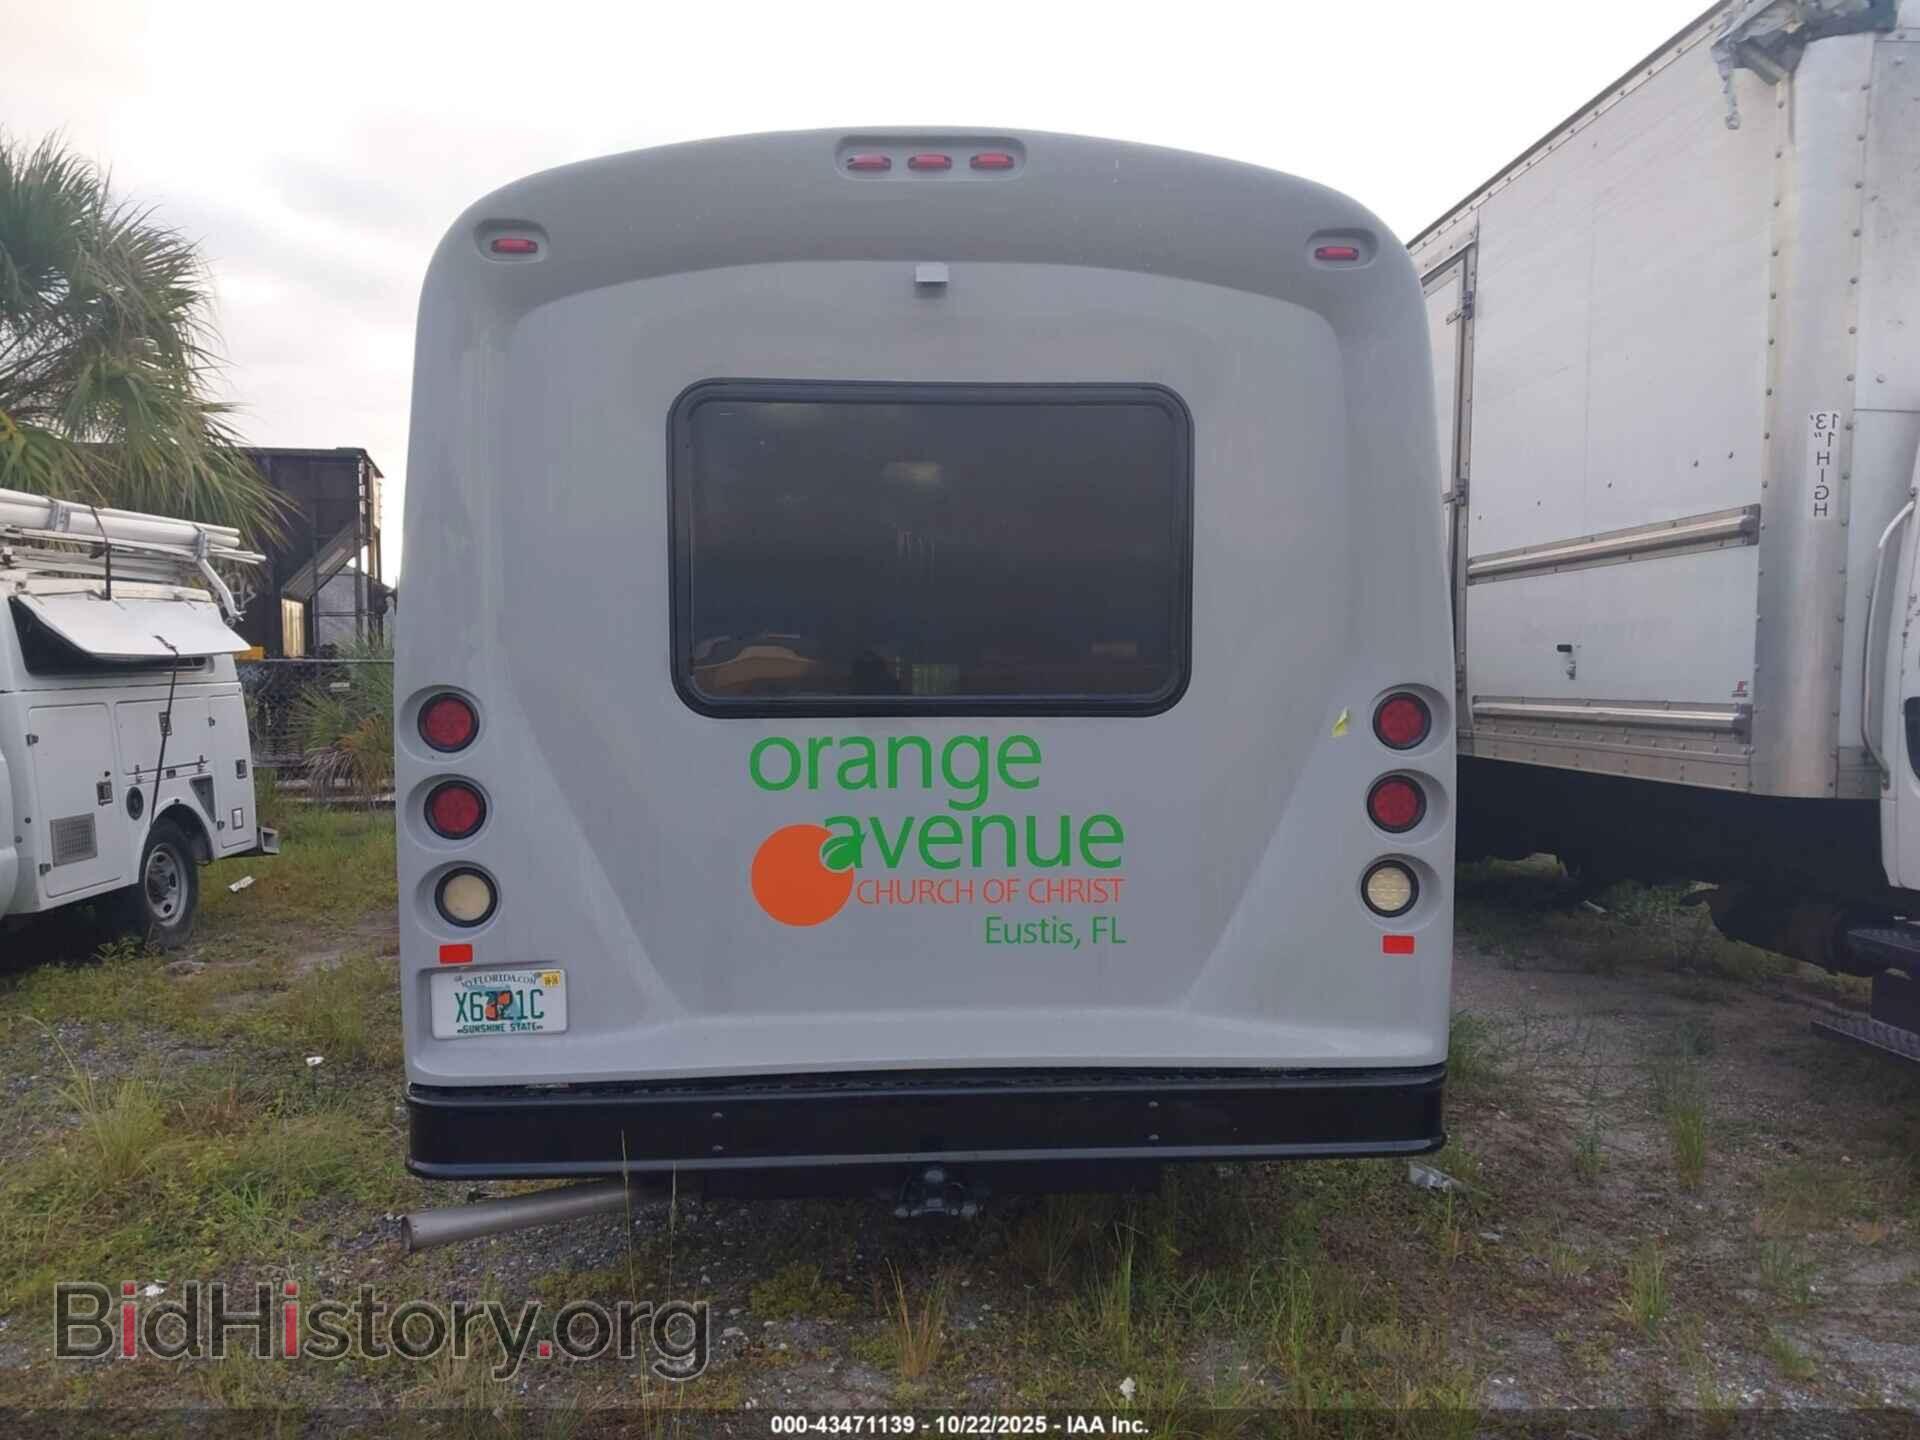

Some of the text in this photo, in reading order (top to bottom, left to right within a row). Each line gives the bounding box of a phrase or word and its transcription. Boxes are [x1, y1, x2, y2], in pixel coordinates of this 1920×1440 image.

[749, 734, 1042, 811] orange
[819, 814, 1125, 873] avenue
[856, 878, 1125, 904] CHURCH OF CHRIST
[985, 915, 1127, 950] Eustis, FL
[462, 1022, 537, 1034] SUNSHINE STATE
